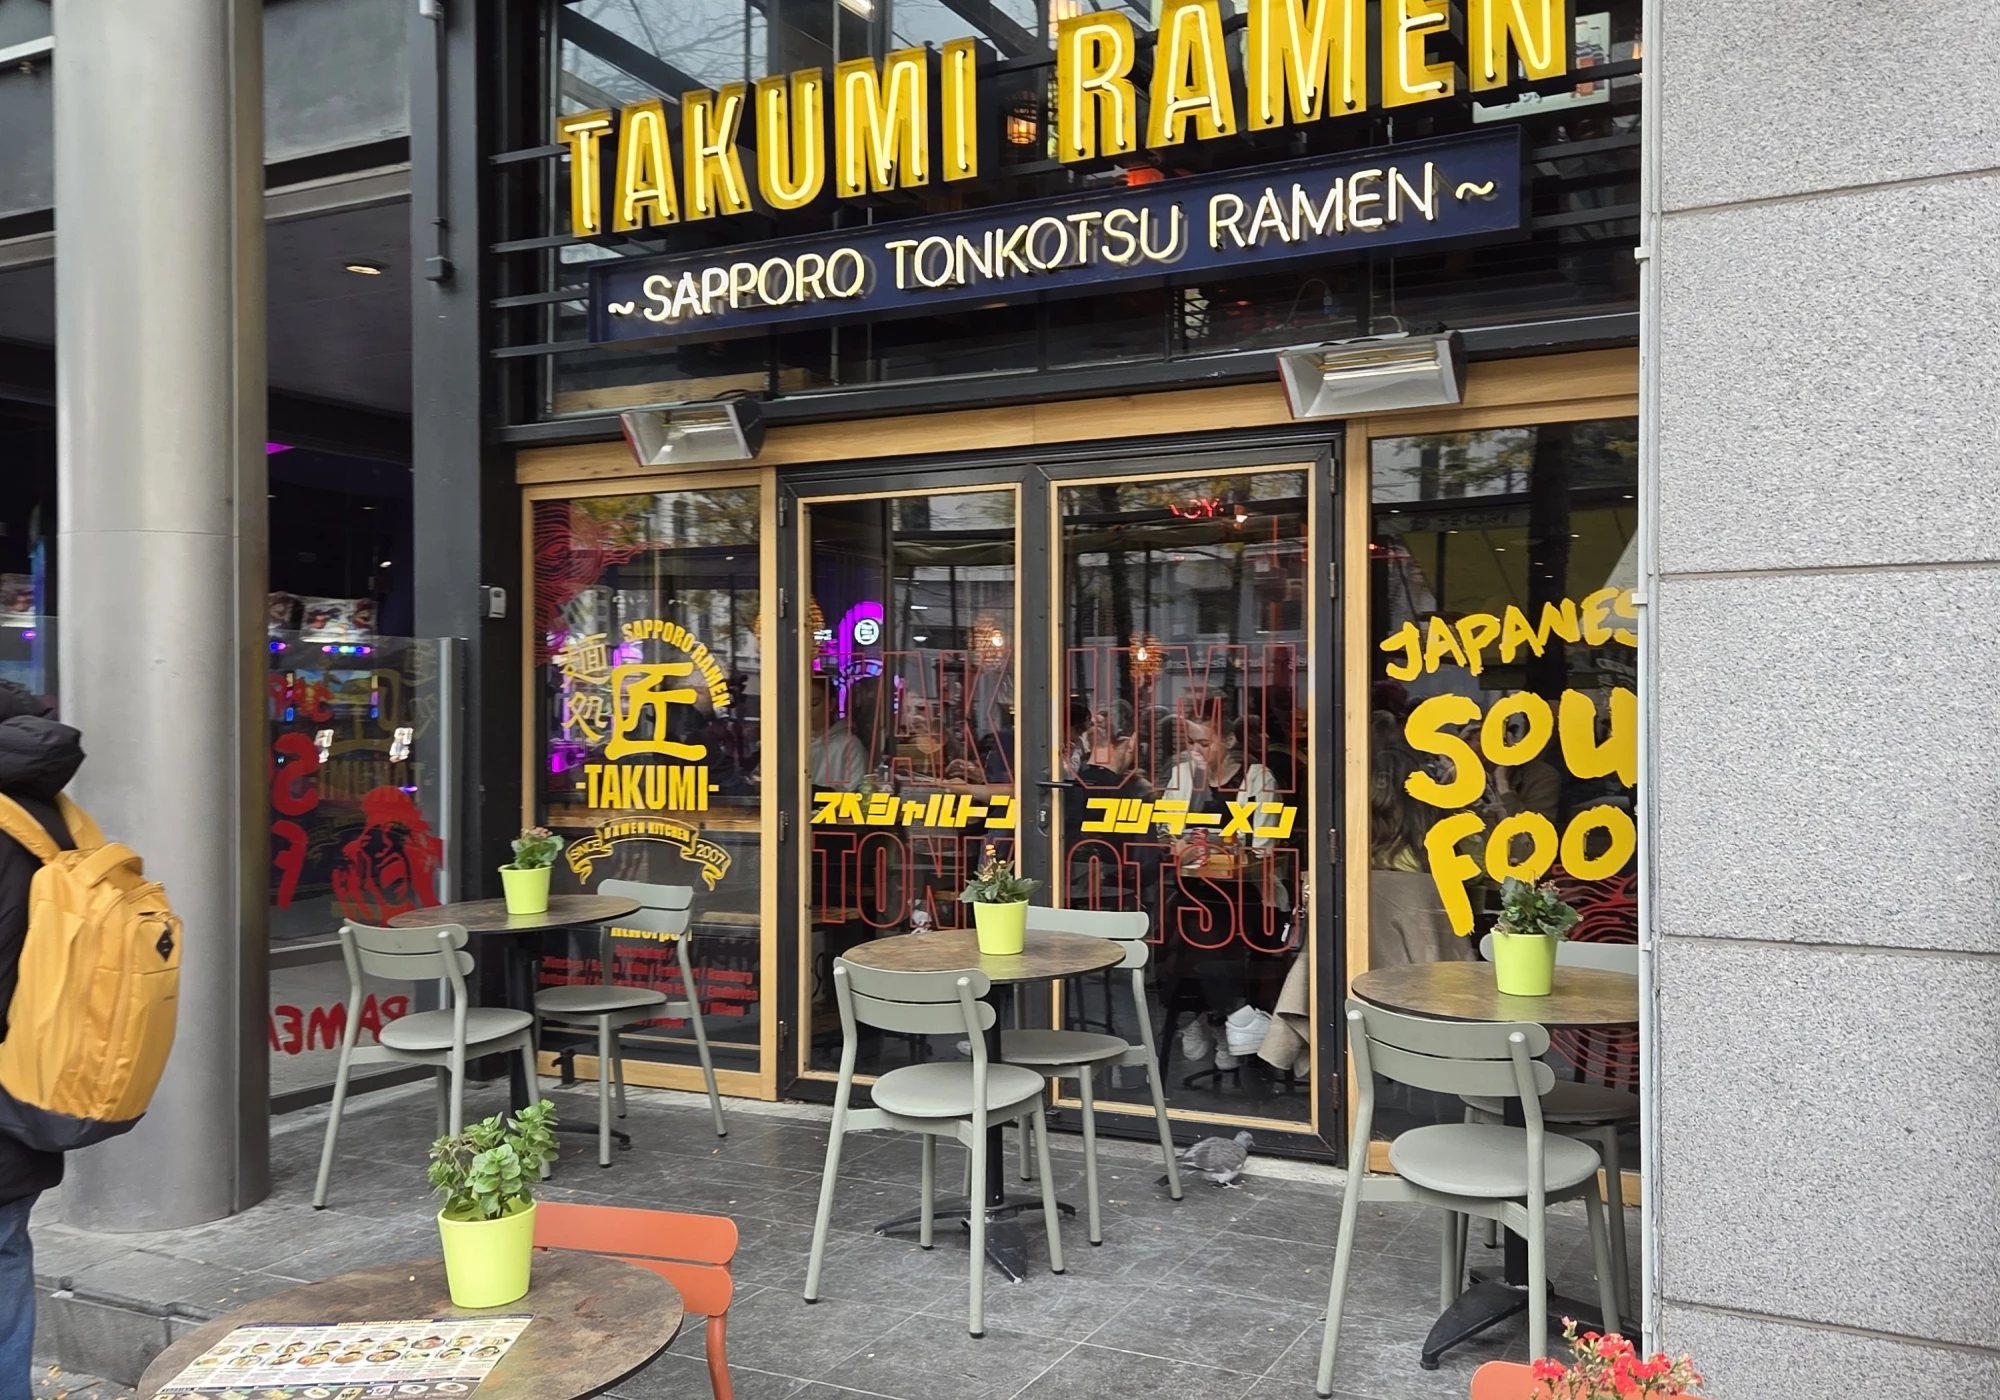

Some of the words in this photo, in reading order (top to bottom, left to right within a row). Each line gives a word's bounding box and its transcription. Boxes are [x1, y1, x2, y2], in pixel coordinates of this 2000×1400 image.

[556, 36, 977, 238] TAKUMI
[1058, 0, 1567, 163] RAMEN
[642, 247, 865, 322] SAPPORO
[885, 204, 1179, 289] TONKOTSU
[1209, 162, 1434, 249] RAMEN
[621, 619, 696, 653] SAPPORO
[690, 643, 731, 708] RAMEN
[604, 661, 708, 762] 匠
[570, 839, 600, 861] SINCE
[696, 844, 727, 866] 2007
[647, 821, 691, 842] KITCHEN
